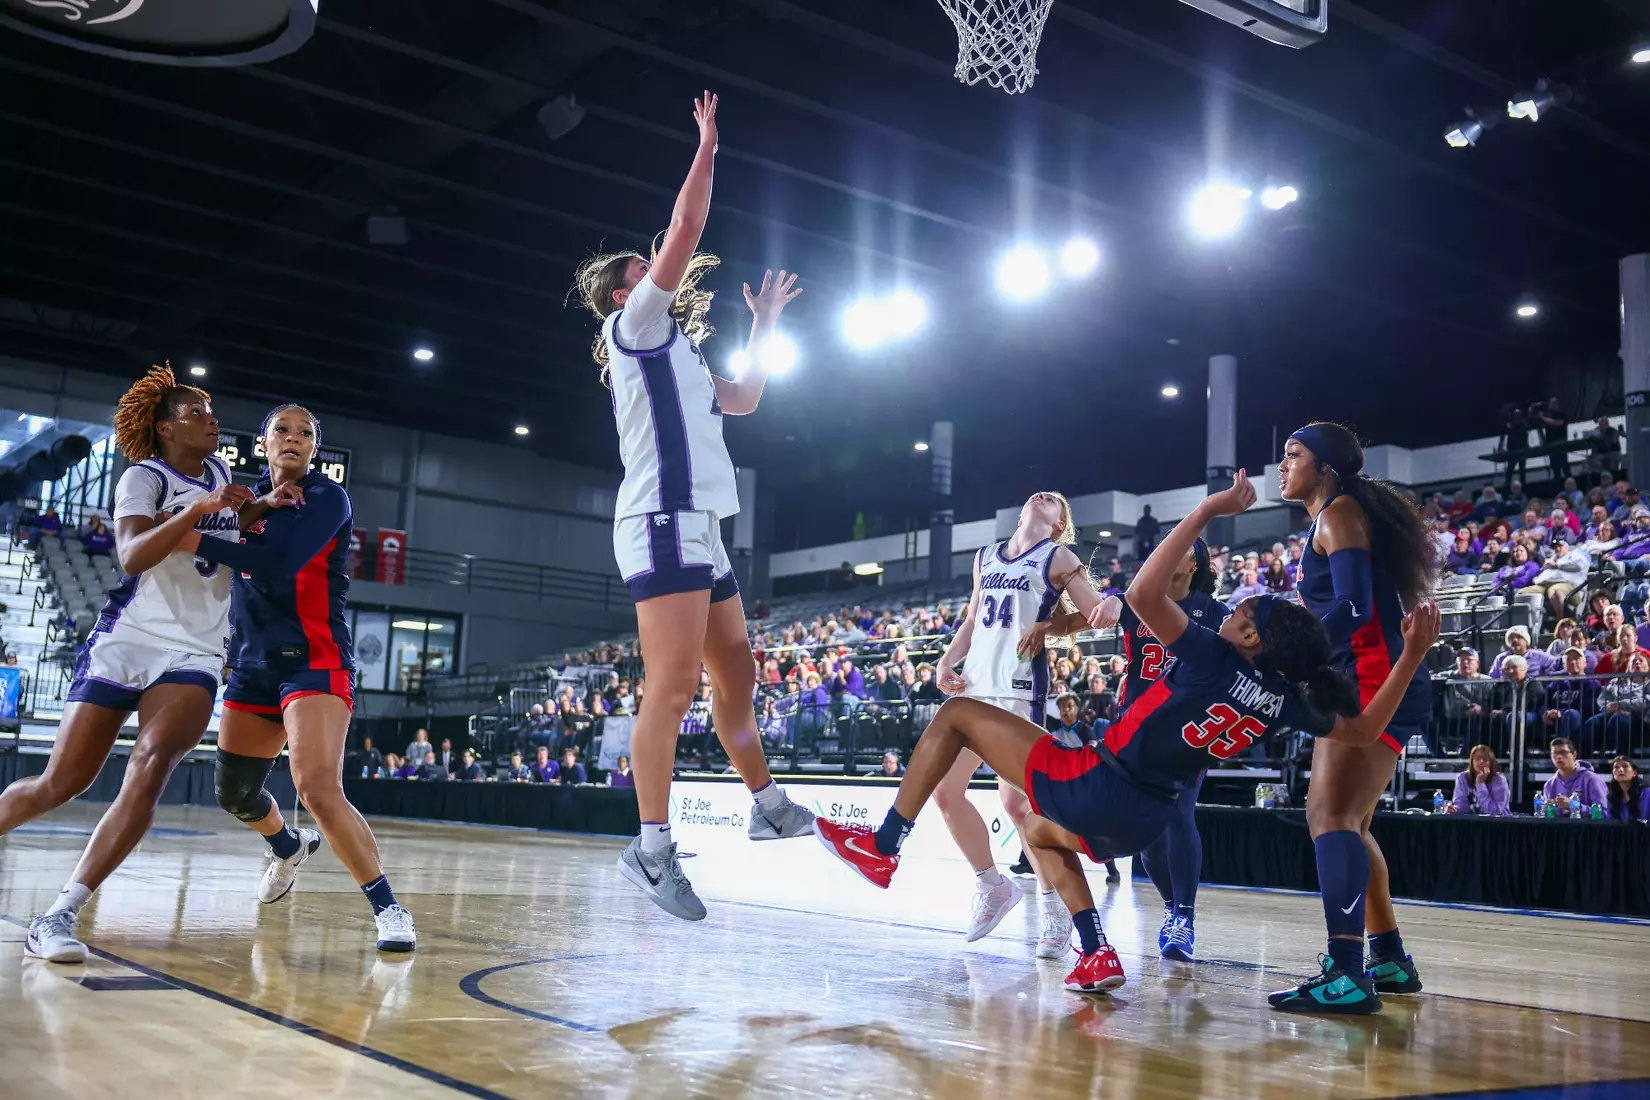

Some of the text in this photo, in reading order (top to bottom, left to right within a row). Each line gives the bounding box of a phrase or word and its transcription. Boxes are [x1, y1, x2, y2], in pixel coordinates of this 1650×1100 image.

[214, 446, 238, 467] 42
[321, 462, 344, 483] 40
[982, 594, 1014, 629] 34
[1182, 703, 1268, 760] 35
[694, 797, 711, 811] Joe
[846, 803, 868, 819] Joe
[680, 811, 730, 826] Petroleum
